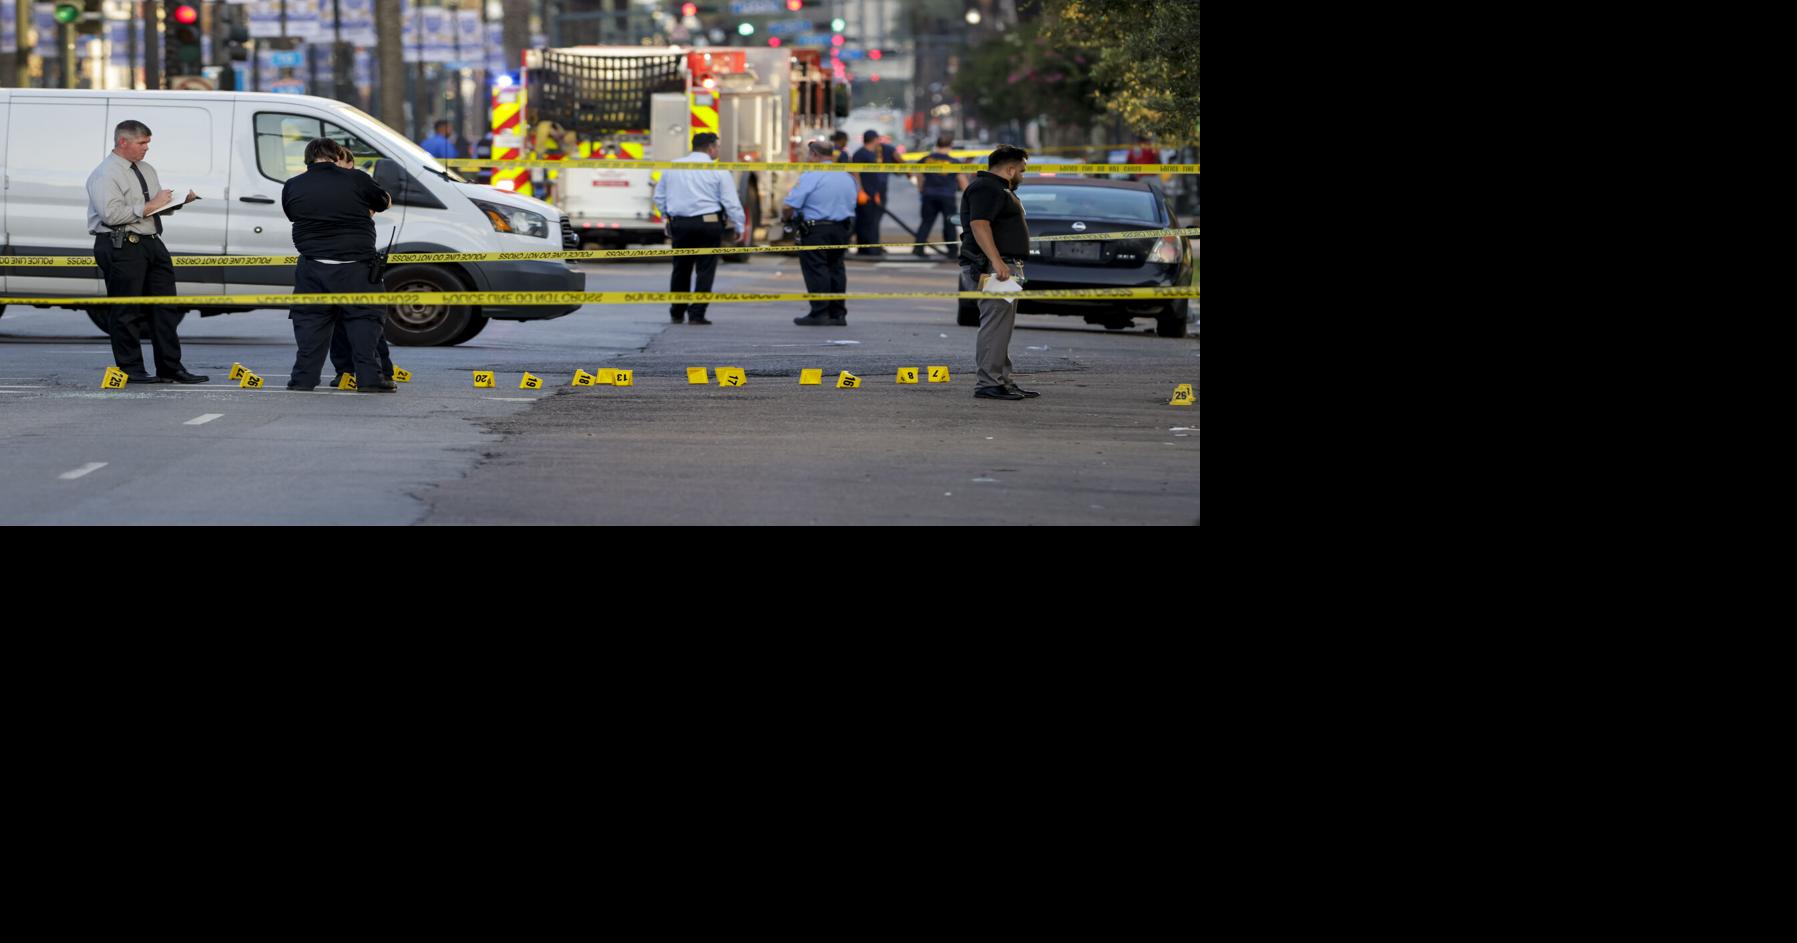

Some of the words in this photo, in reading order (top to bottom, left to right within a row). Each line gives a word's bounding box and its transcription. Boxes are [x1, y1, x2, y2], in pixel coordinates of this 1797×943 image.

[10, 257, 26, 265] LINE
[27, 257, 53, 265] POLICE
[67, 257, 92, 265] CROSS
[109, 376, 122, 388] 25
[248, 376, 260, 386] 26
[475, 374, 488, 383] 20
[526, 378, 538, 387] 19
[579, 375, 590, 385] 18
[727, 375, 739, 386] 17
[843, 377, 856, 387] 16
